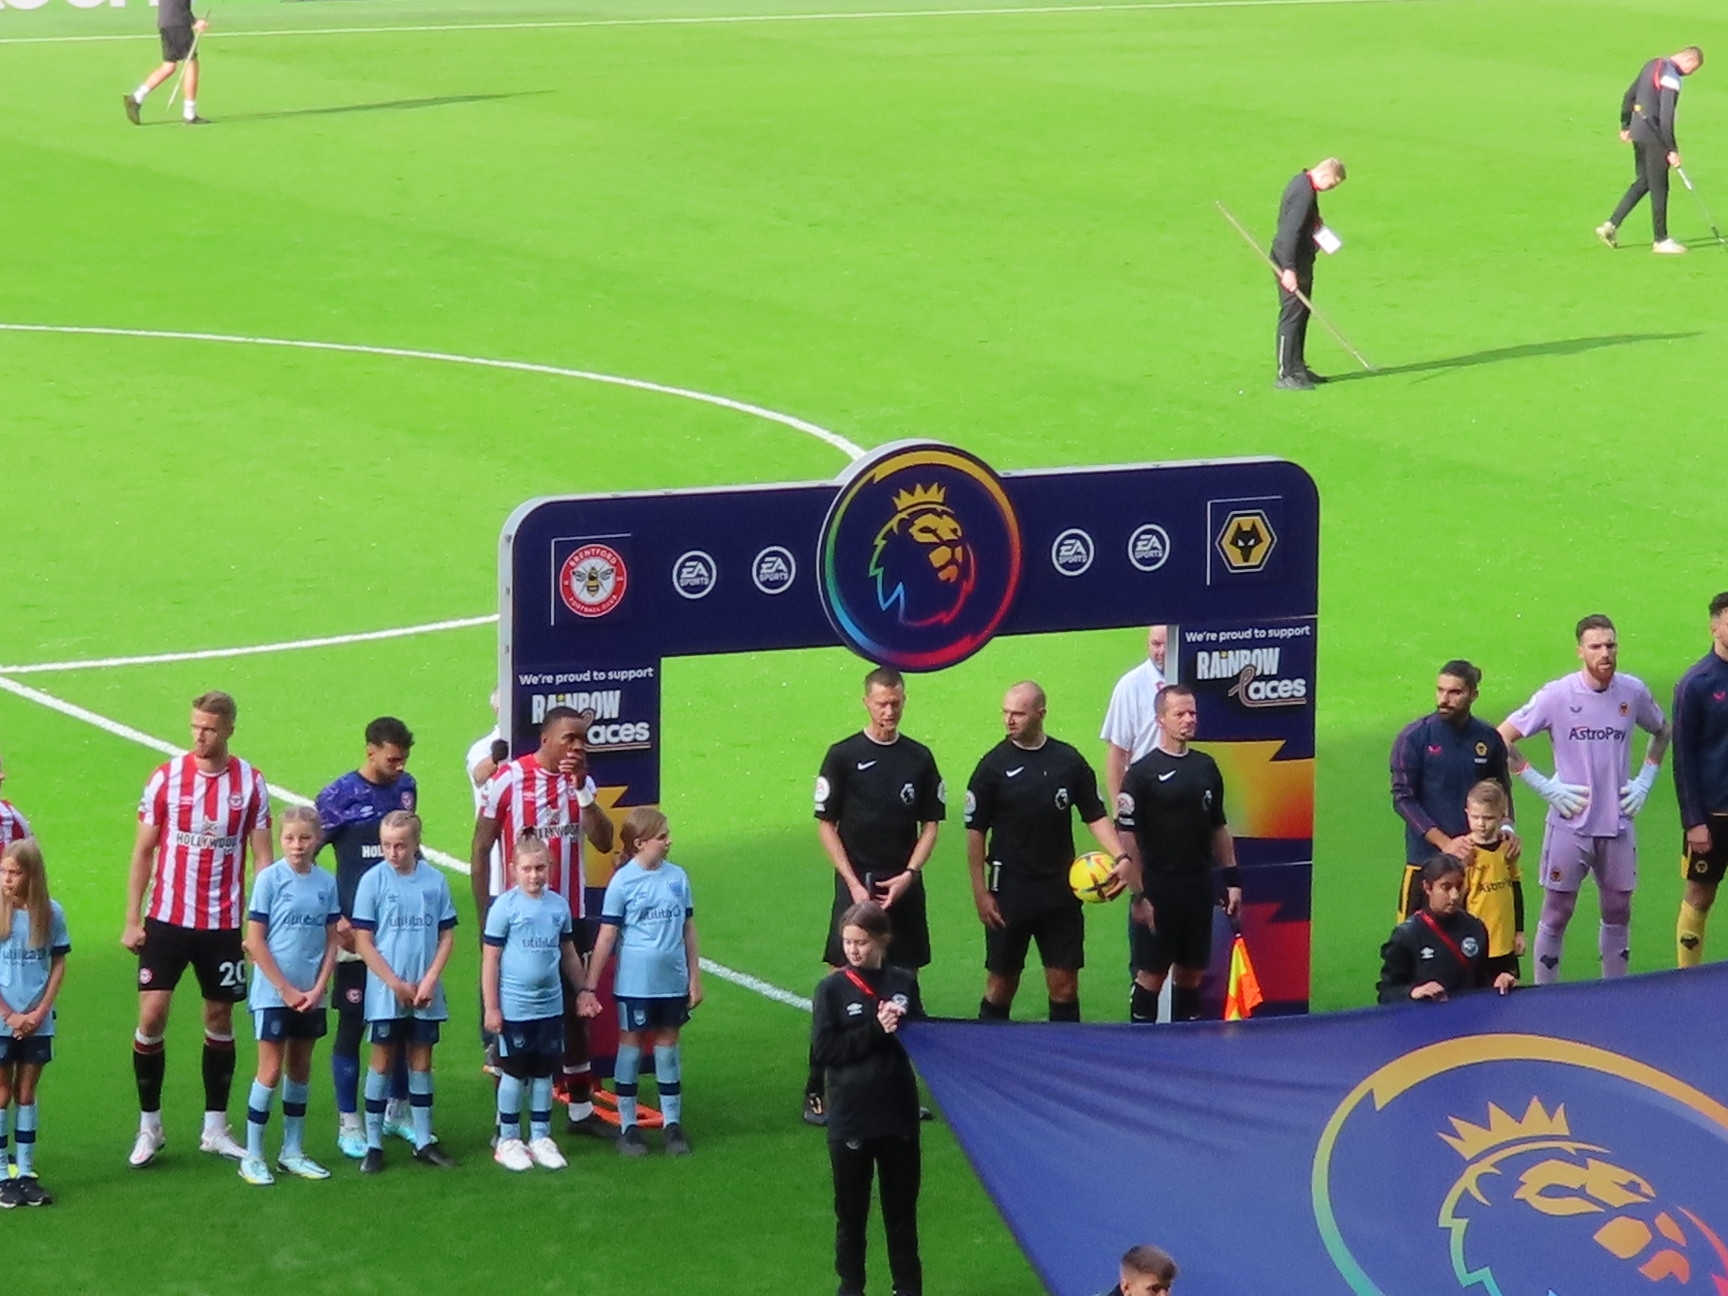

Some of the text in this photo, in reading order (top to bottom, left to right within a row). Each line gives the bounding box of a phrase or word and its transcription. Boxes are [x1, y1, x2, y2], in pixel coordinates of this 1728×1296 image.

[1059, 538, 1087, 556] EA
[1135, 534, 1163, 551] EA
[679, 561, 710, 579] EA
[759, 556, 789, 573] EA
[1185, 625, 1311, 643] We're proud to support
[518, 667, 654, 685] We're proud to support
[1568, 725, 1627, 743] AstroPay
